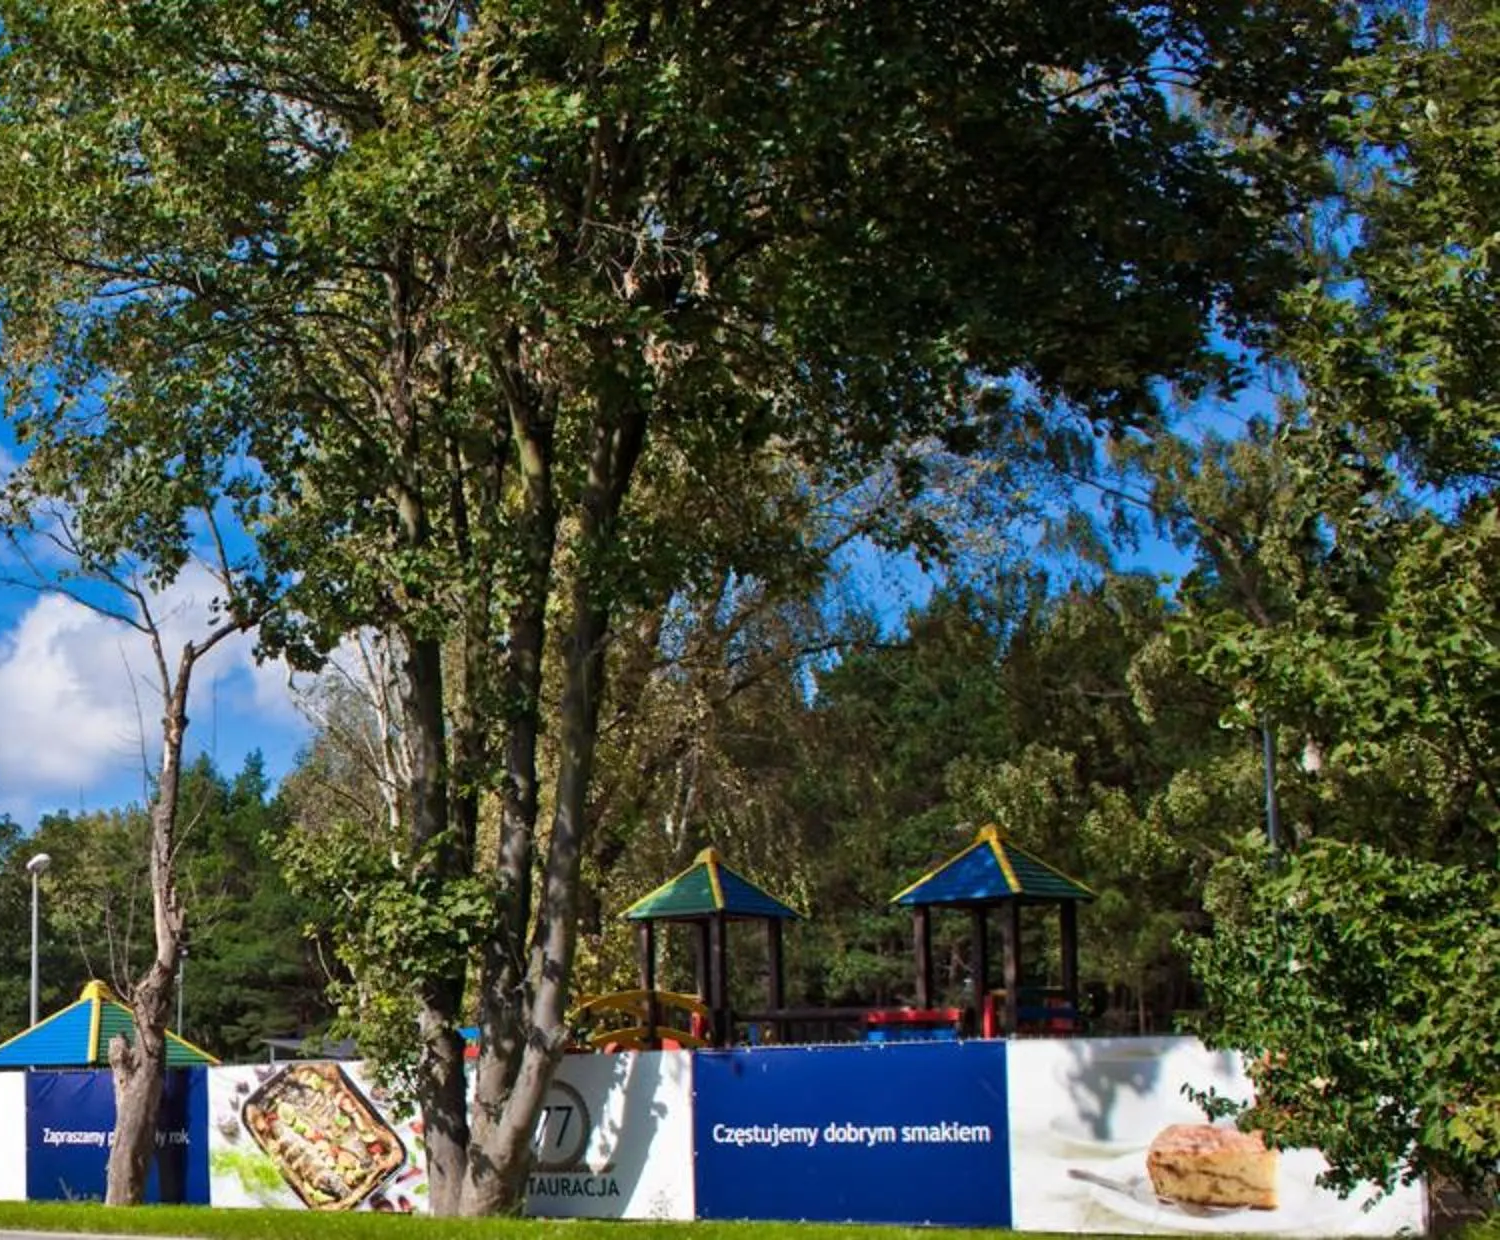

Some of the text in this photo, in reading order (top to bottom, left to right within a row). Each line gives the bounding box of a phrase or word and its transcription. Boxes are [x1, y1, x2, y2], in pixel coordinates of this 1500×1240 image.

[43, 1128, 106, 1148] Zapraszamy
[713, 1121, 991, 1147] Częstujemy dobrym smakiem
[528, 1177, 620, 1197] TAURACJA
